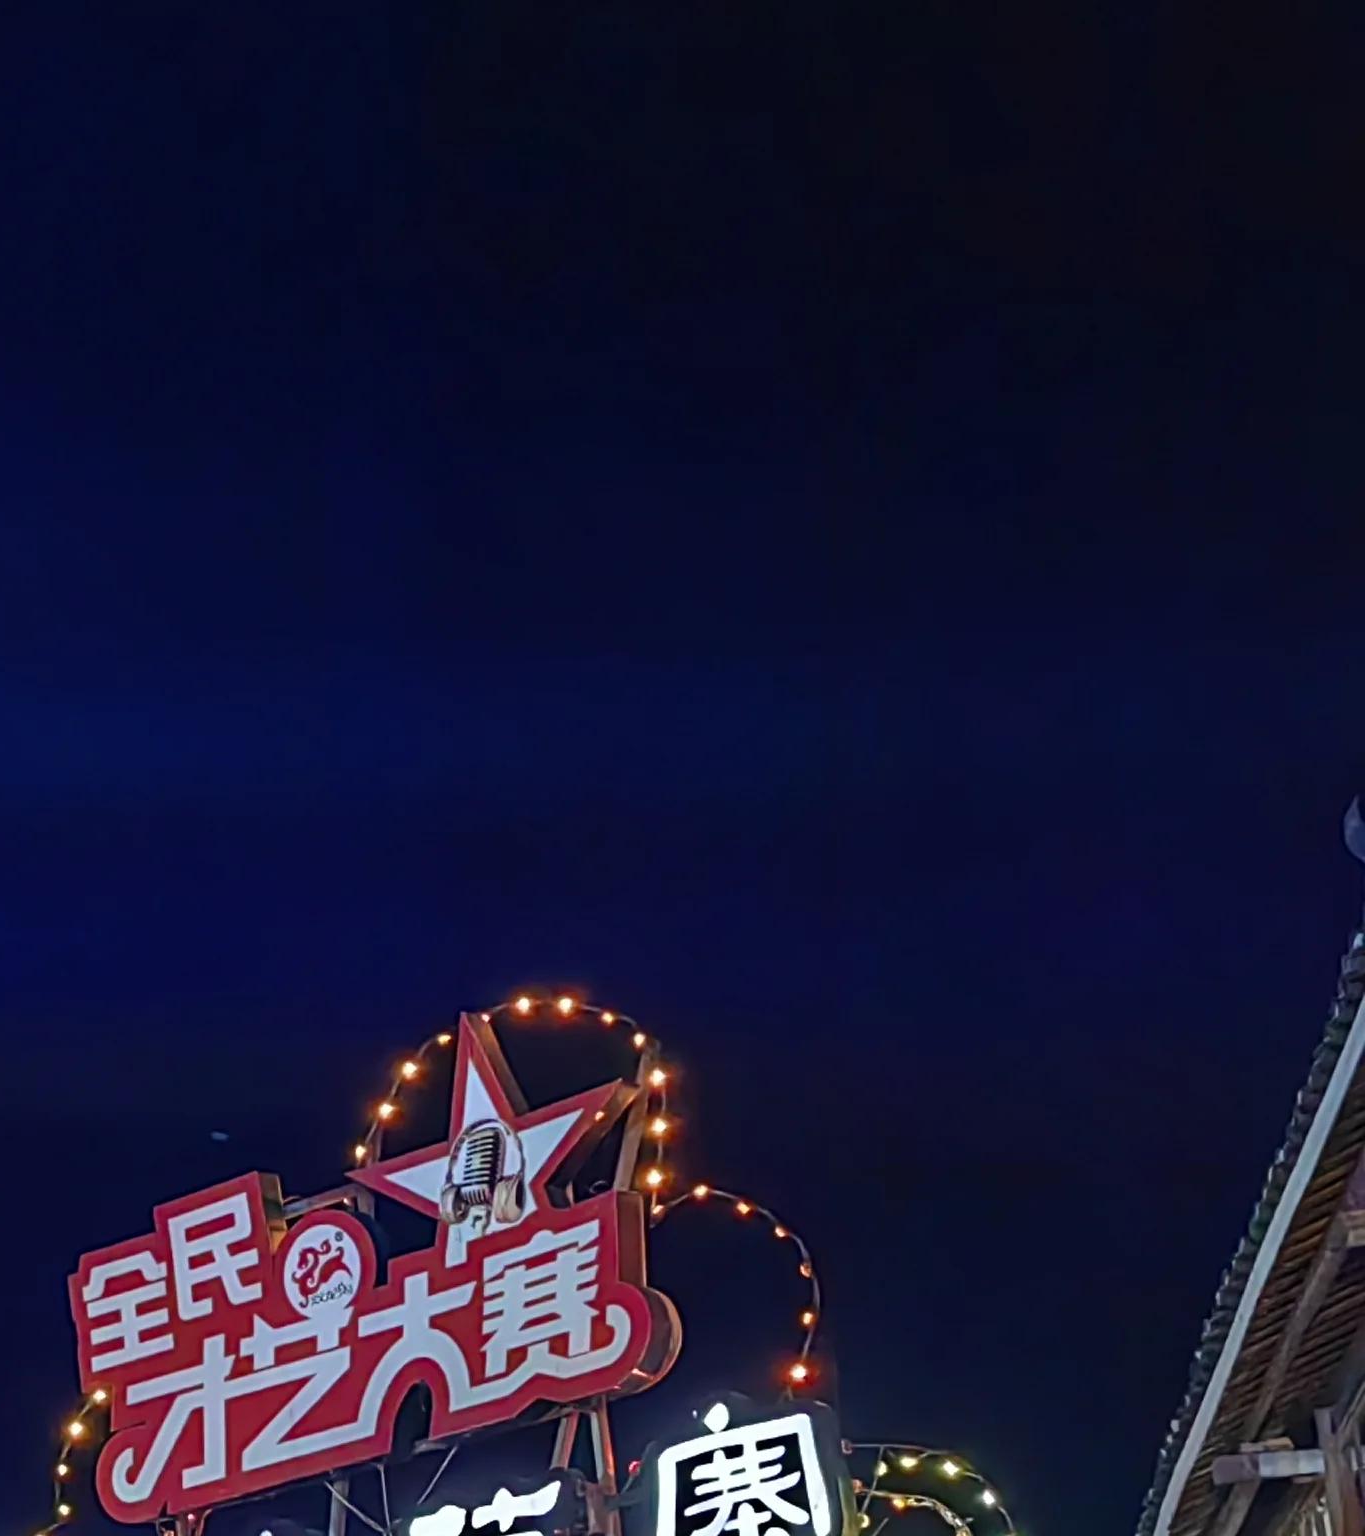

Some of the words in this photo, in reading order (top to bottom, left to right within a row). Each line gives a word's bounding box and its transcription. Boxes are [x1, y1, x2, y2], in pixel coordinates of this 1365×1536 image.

[82, 1192, 263, 1372] 全民
[112, 1218, 631, 1504] 才艺大赛
